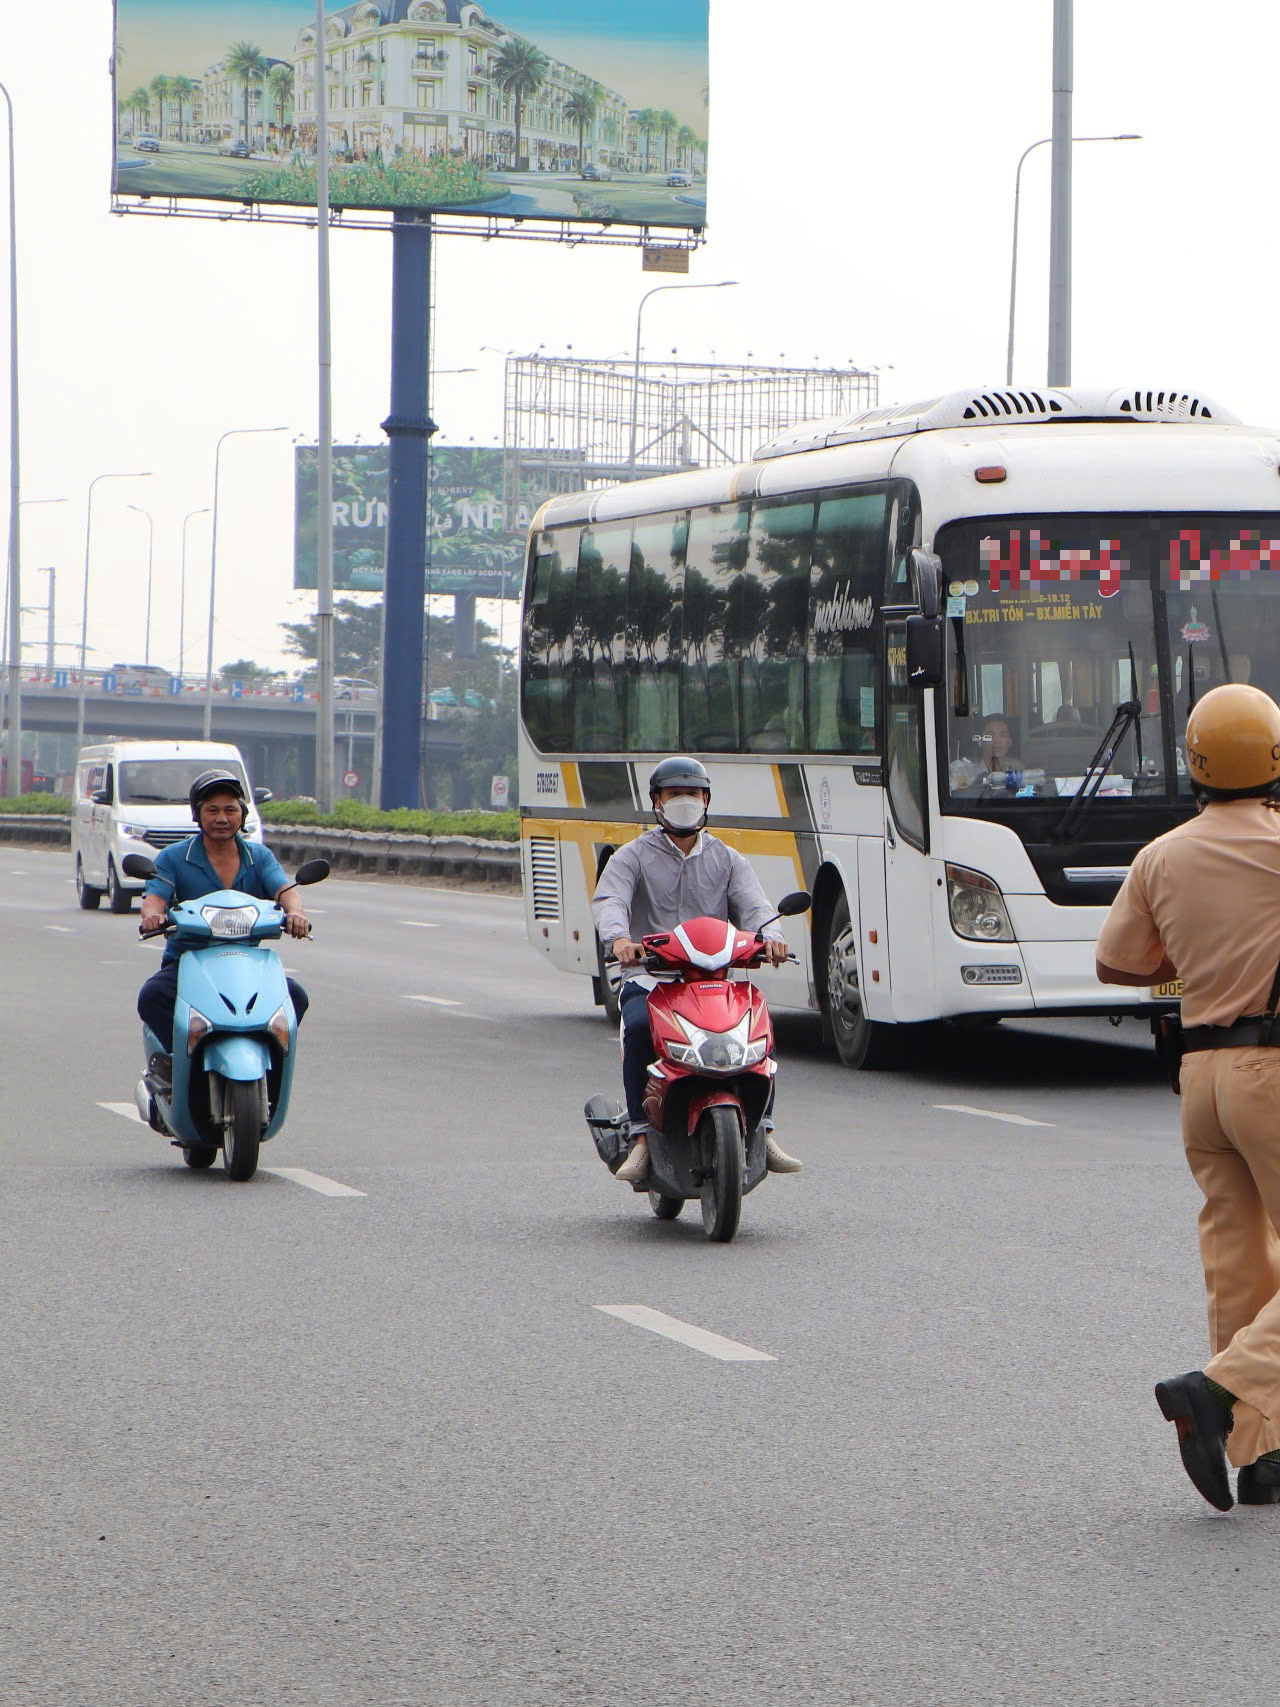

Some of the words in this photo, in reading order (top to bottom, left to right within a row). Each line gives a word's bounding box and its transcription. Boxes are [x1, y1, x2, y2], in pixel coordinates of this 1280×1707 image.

[331, 494, 388, 528] RỪN
[1002, 604, 1024, 622] TÔN
[1082, 602, 1103, 619] TÂY
[1159, 982, 1184, 996] 005
